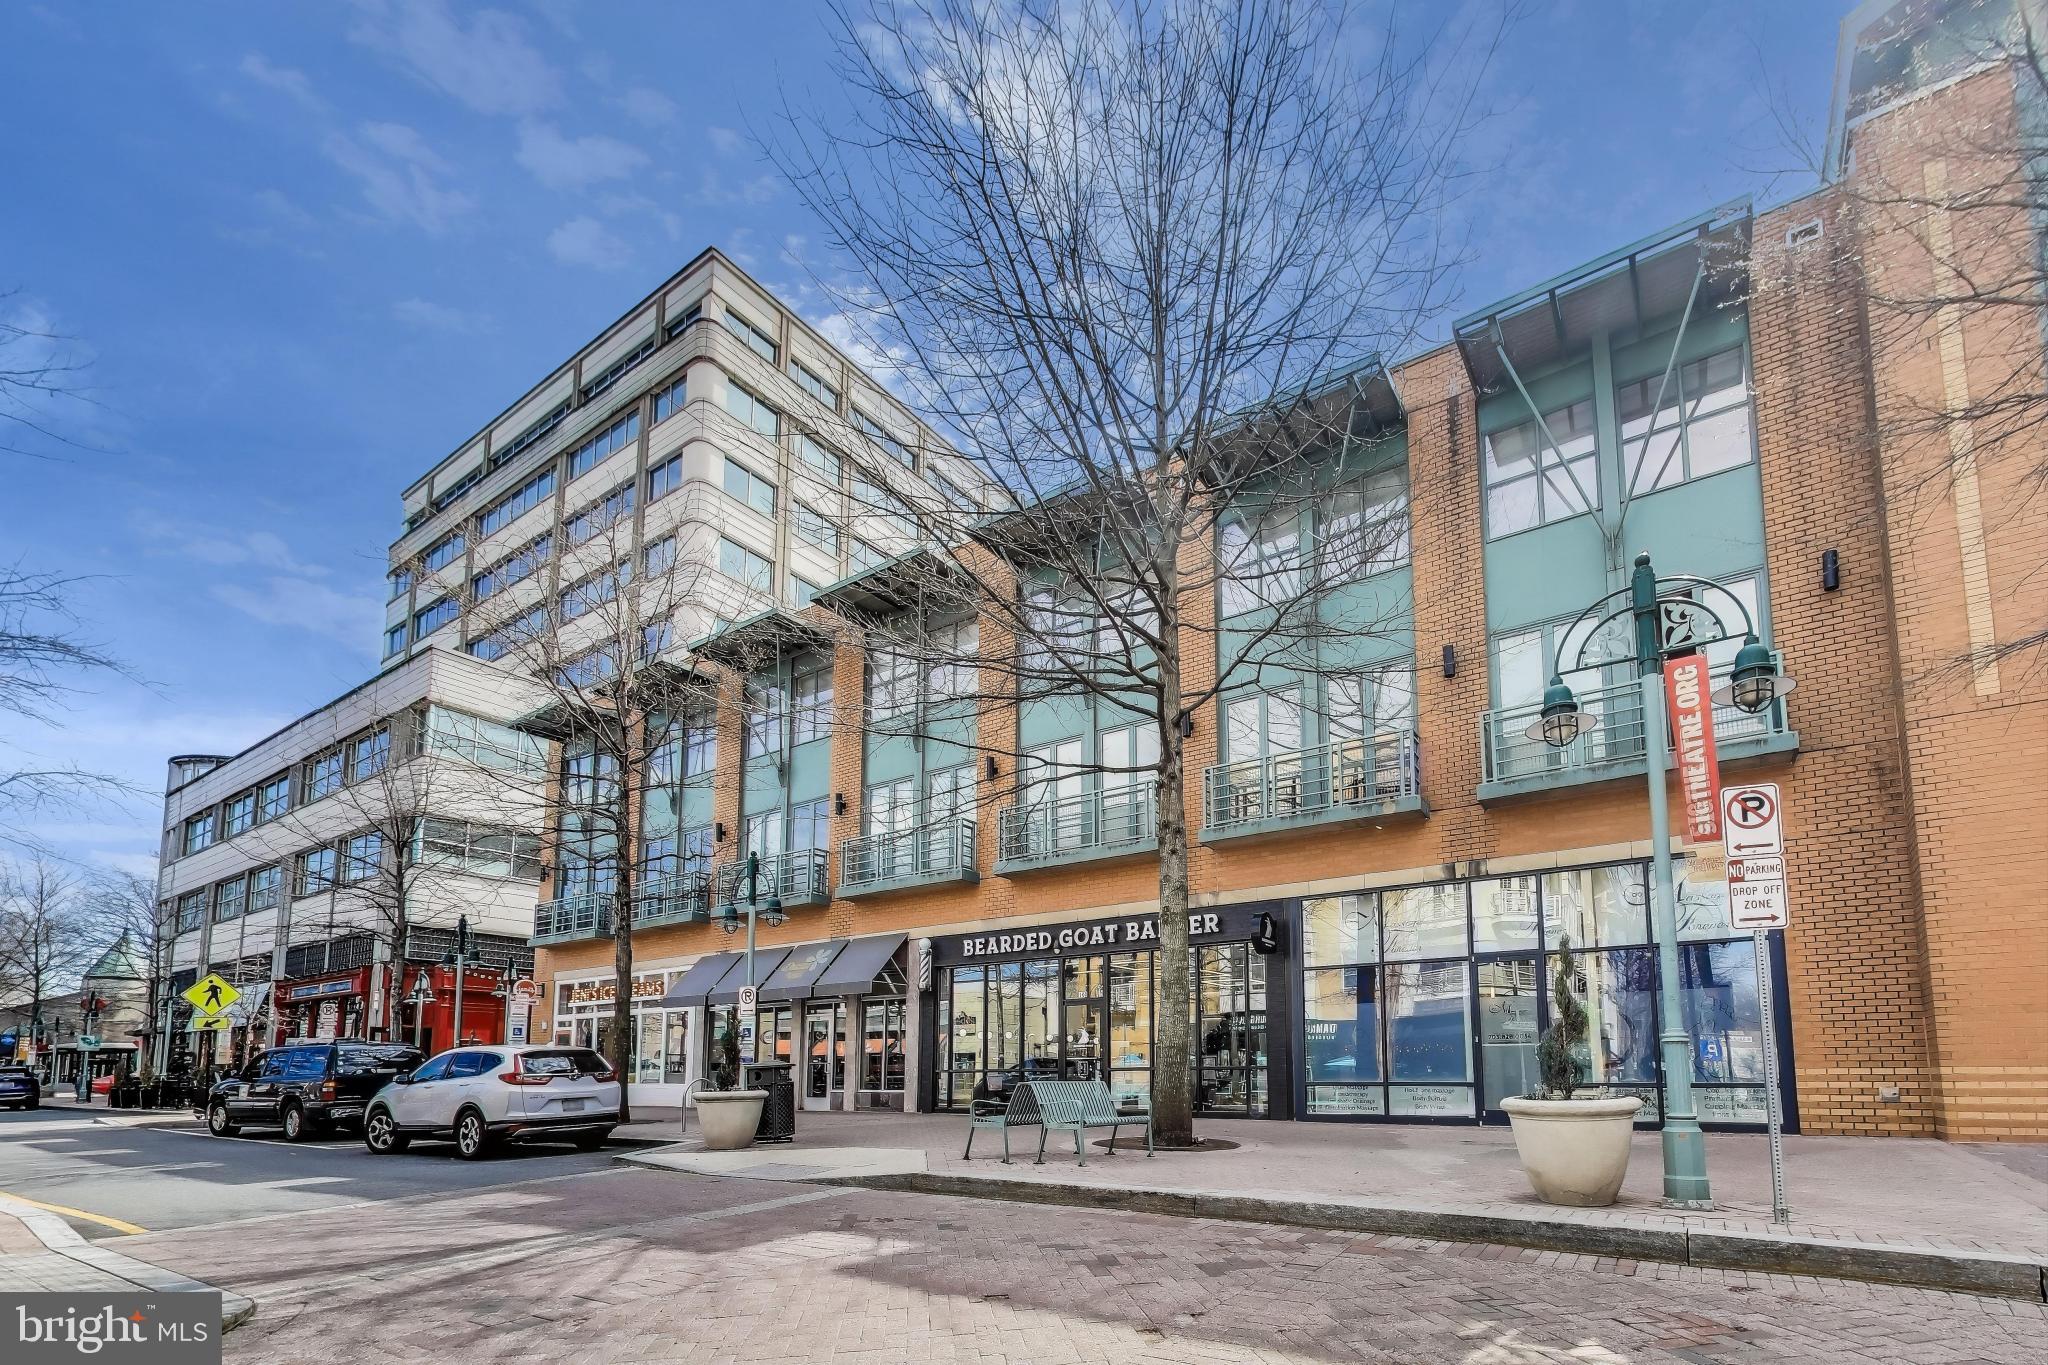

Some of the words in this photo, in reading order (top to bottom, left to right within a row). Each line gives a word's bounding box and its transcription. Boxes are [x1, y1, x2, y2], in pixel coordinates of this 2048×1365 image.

[1729, 864, 1744, 878] NO
[1746, 864, 1781, 875] PARKING
[1732, 886, 1758, 897] DROP
[1764, 884, 1782, 895] OFF
[1744, 900, 1773, 910] ZONE
[963, 931, 1052, 957] BEARDED
[1059, 923, 1119, 948] GOAT
[1126, 913, 1220, 942] BAER
